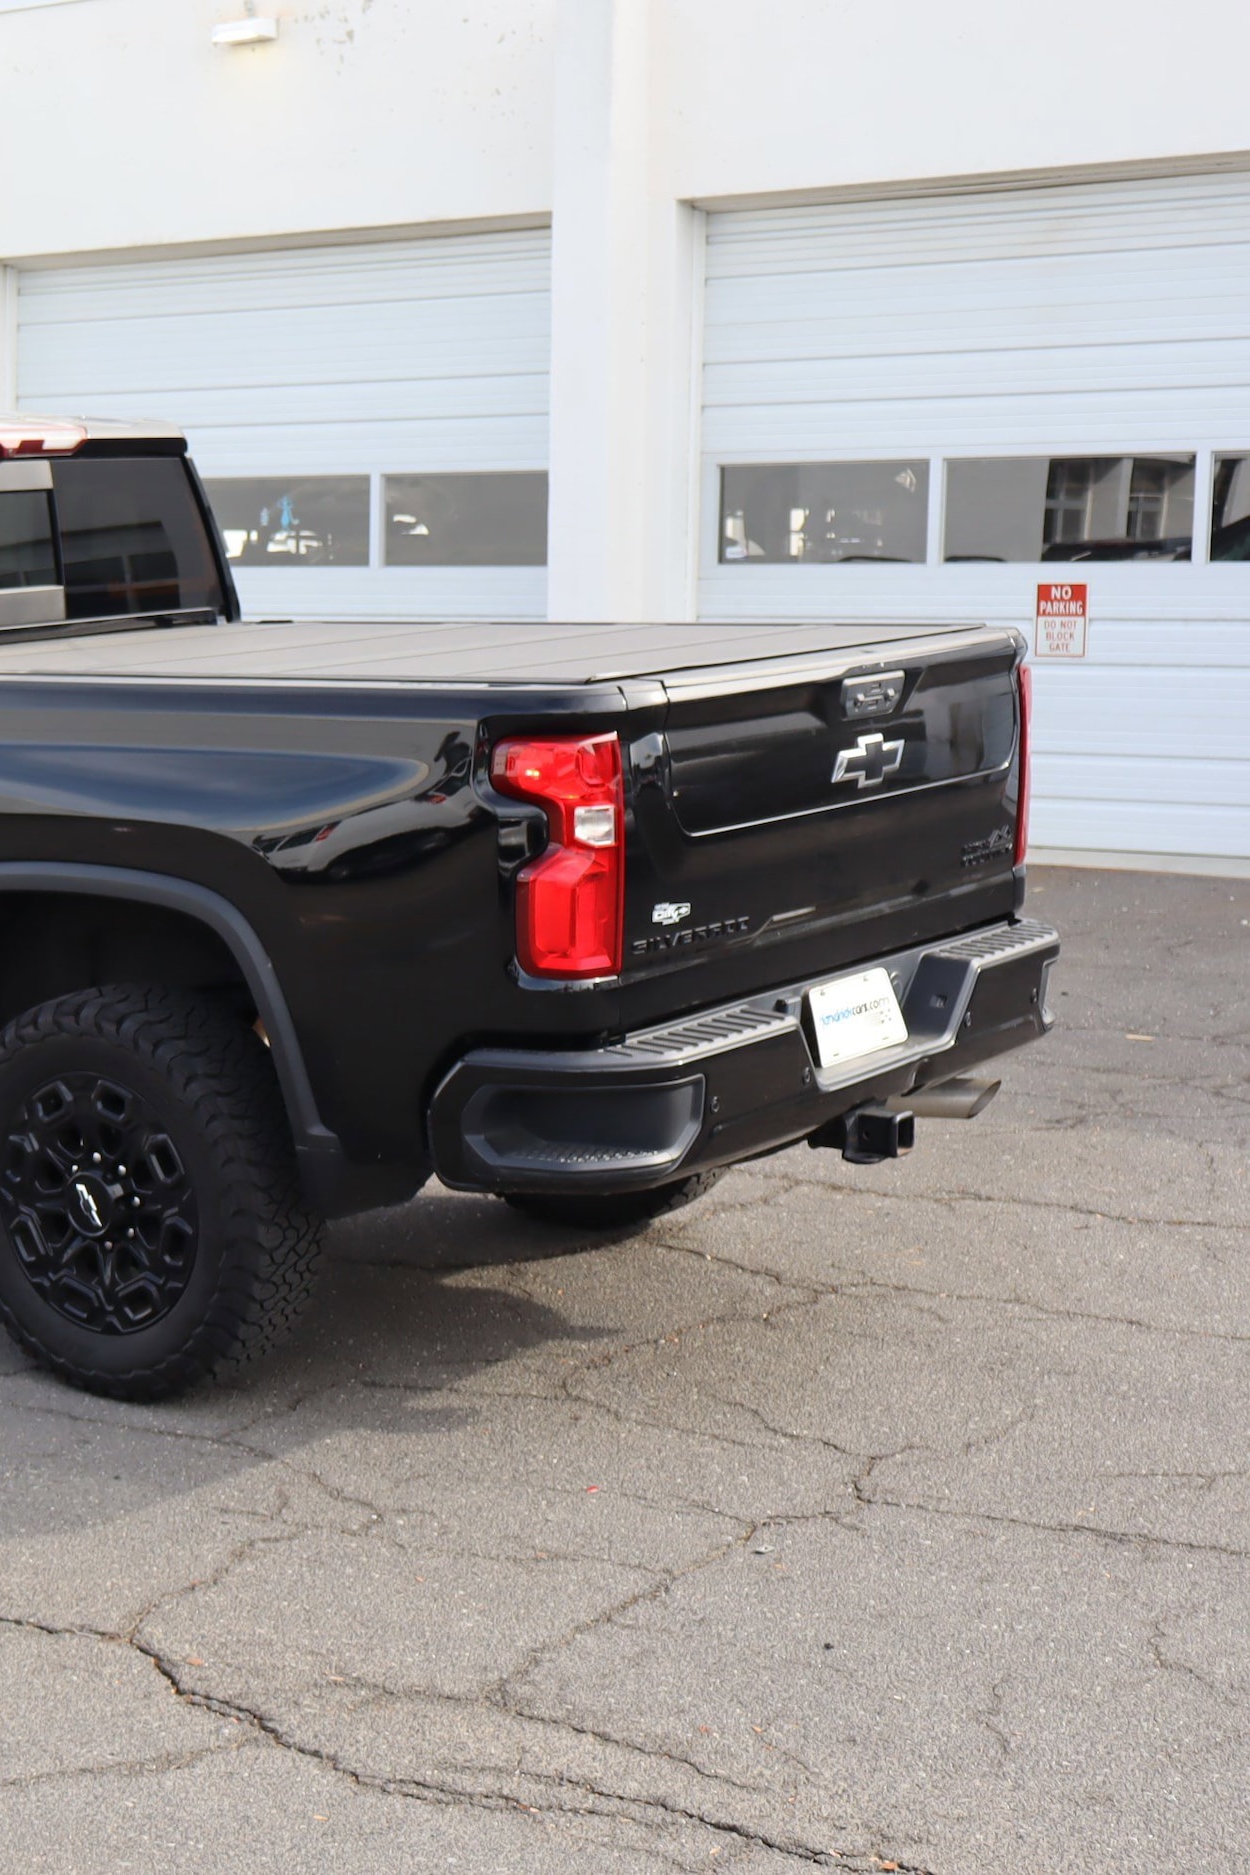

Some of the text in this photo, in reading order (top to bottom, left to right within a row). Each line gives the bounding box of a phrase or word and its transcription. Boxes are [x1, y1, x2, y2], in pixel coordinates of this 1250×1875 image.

[1051, 586, 1072, 600] NO
[1039, 601, 1083, 615] PARKING
[1044, 620, 1077, 630] DO NOT
[1045, 631, 1075, 641] BLOCK
[1049, 642, 1071, 653] GATE
